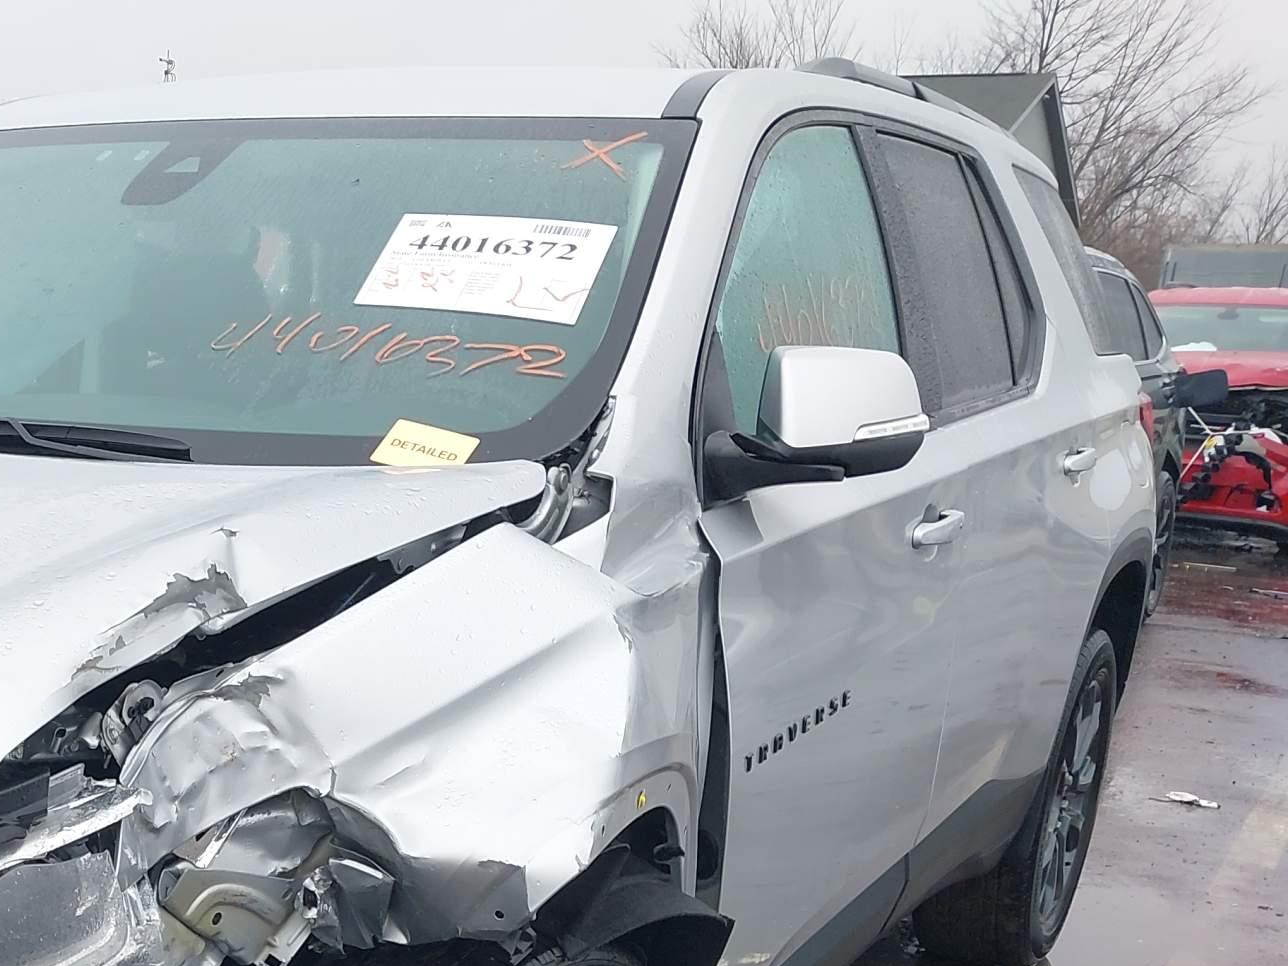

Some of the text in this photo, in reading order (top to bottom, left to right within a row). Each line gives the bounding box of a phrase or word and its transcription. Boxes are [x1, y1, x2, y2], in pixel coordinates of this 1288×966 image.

[408, 233, 579, 262] 44016372
[210, 312, 569, 379] 44016372
[389, 437, 459, 462] DETAILED
[743, 689, 852, 774] TRAVERSE
